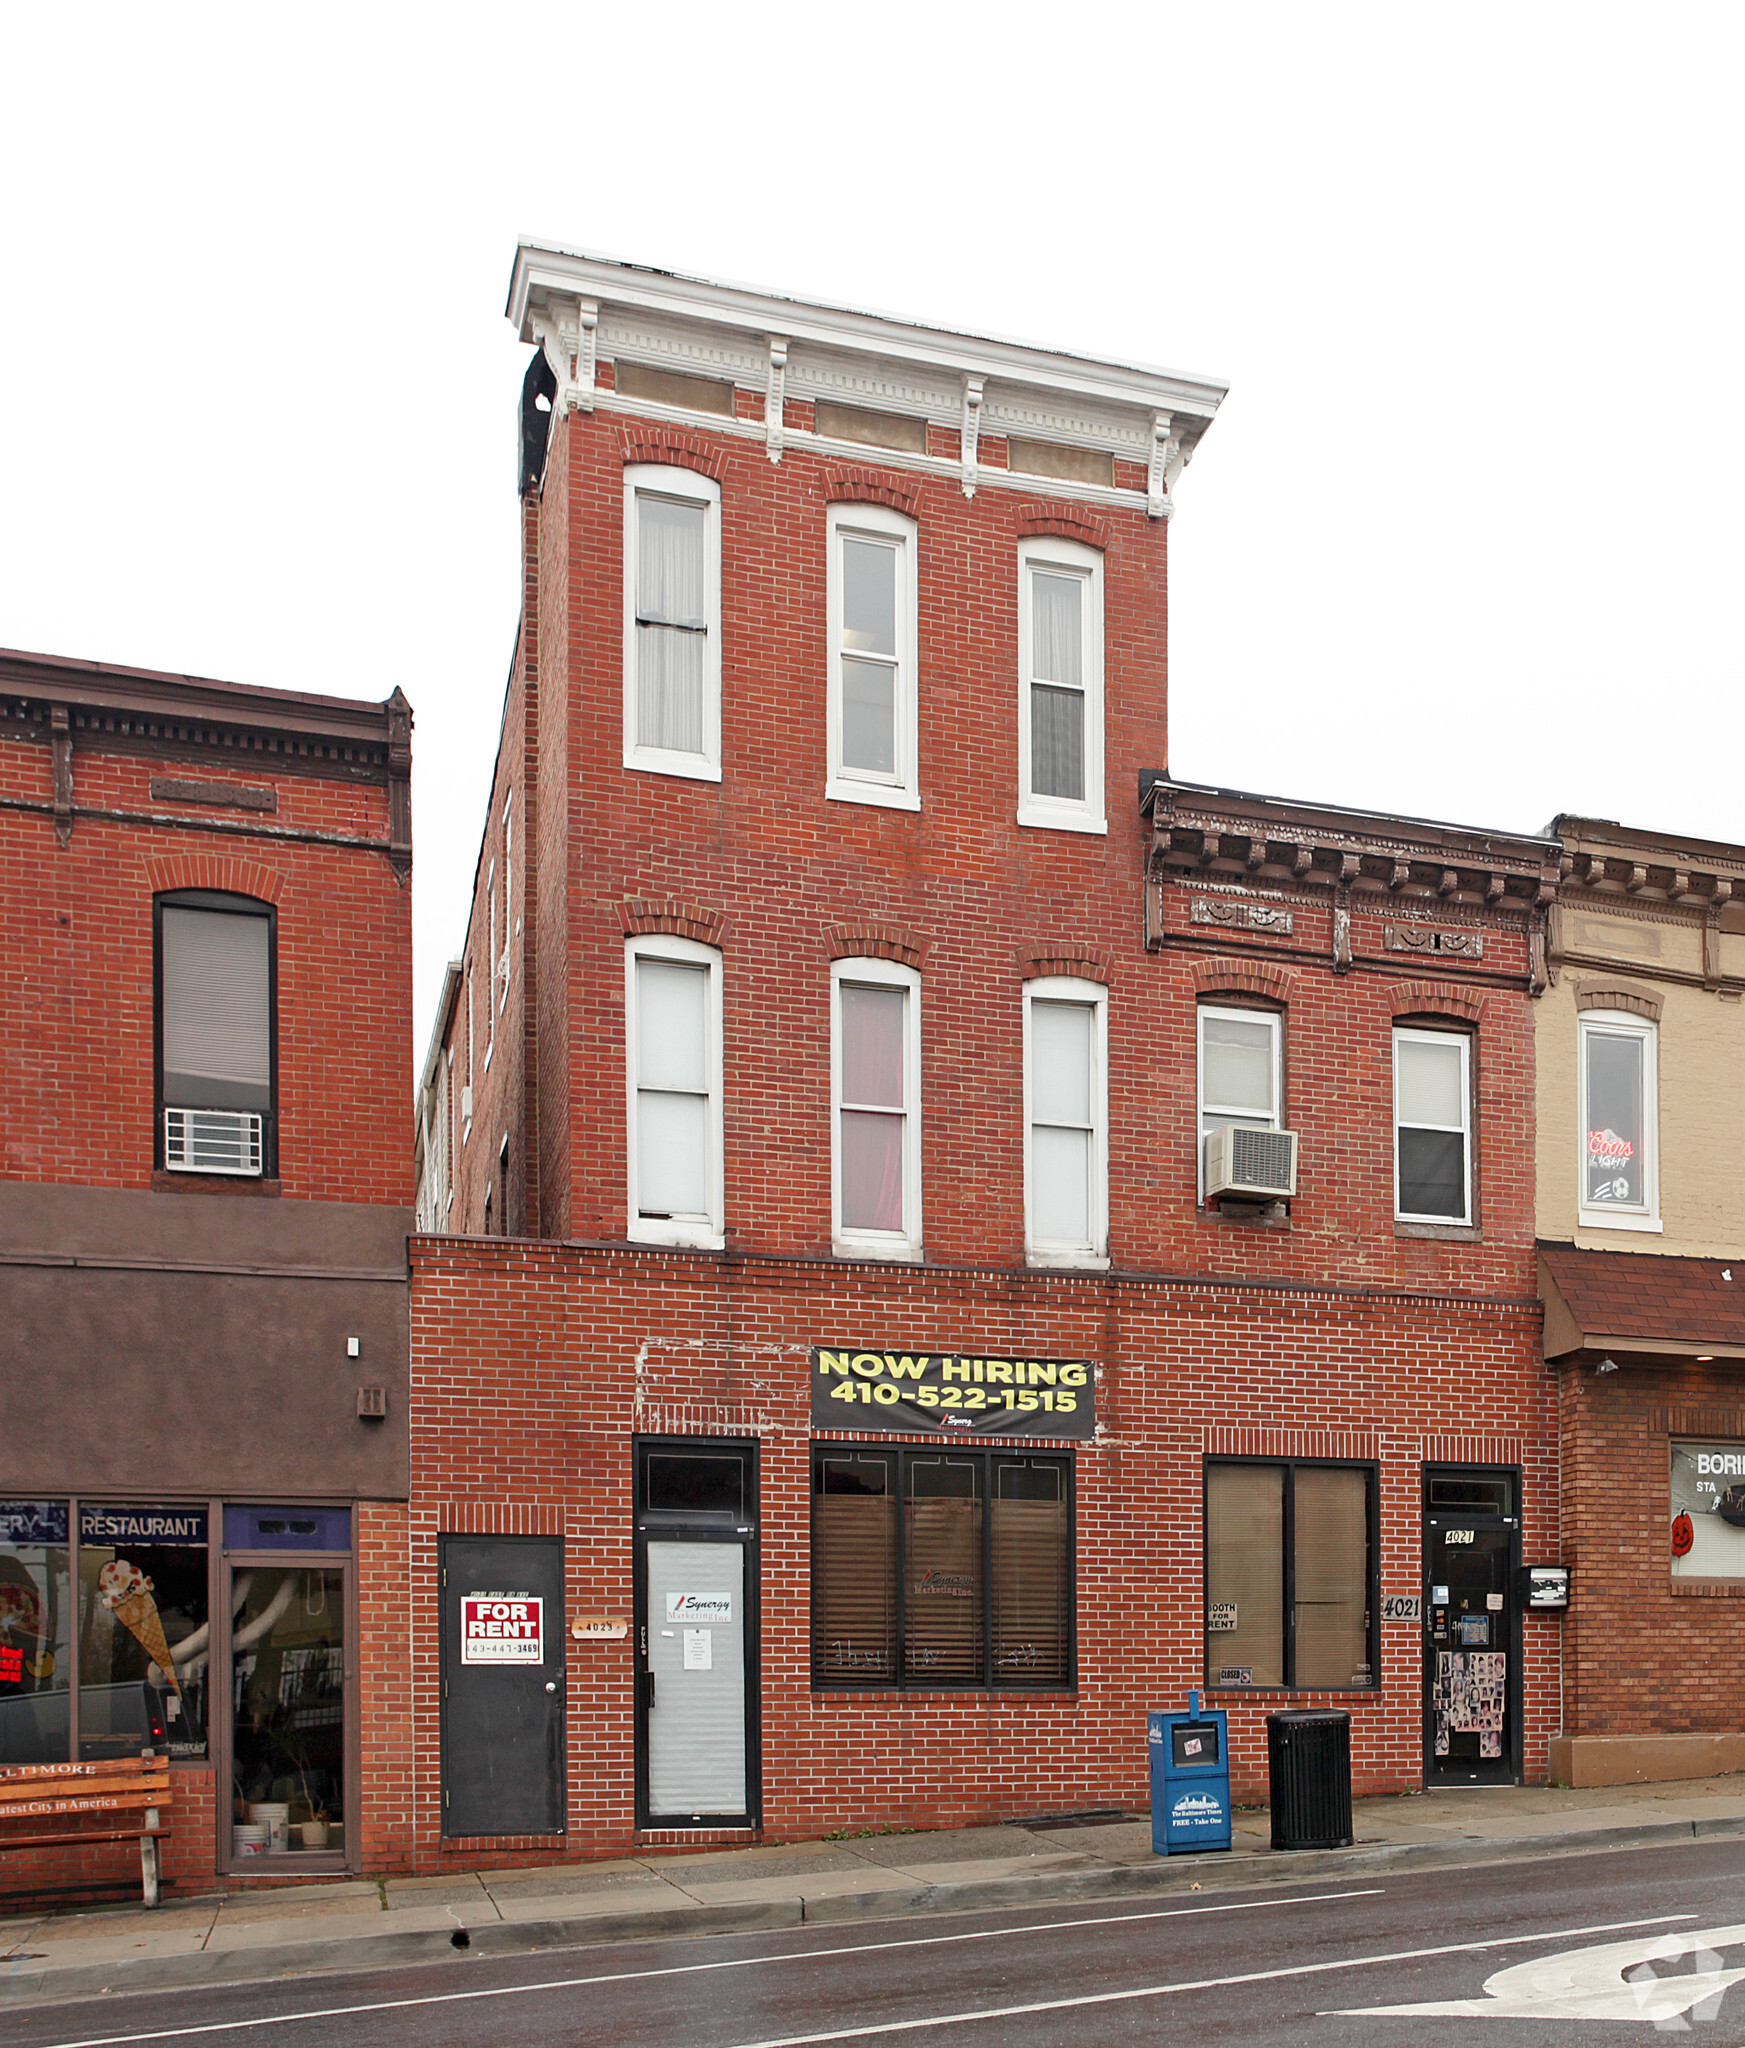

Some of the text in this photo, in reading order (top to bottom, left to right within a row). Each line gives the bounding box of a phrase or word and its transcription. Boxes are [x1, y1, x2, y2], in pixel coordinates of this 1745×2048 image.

[1588, 1130, 1635, 1157] Coors
[1592, 1154, 1630, 1168] LIGHT
[818, 1351, 1087, 1386] NOW HIRING
[830, 1381, 1077, 1412] 410-522-1515
[1697, 1453, 1745, 1475] BORI
[1696, 1481, 1716, 1493] STA
[81, 1516, 201, 1536] RESTAURANT
[1446, 1530, 1472, 1542] 4021
[932, 1572, 974, 1585] Synergy
[914, 1585, 957, 1596] Marketing
[685, 1596, 730, 1612] Synergy
[1208, 1603, 1236, 1612] BOOTH
[1383, 1598, 1419, 1617] 4021
[477, 1603, 528, 1620] FOR
[668, 1611, 714, 1621] Marketing
[469, 1621, 537, 1637] RENT
[585, 1623, 613, 1632] 4023
[1208, 1620, 1235, 1628] RENT
[1221, 1669, 1240, 1679] CLOSED
[29, 1801, 54, 1814] City
[56, 1800, 67, 1811] in
[69, 1797, 118, 1810] America
[1172, 1819, 1190, 1827] FREE
